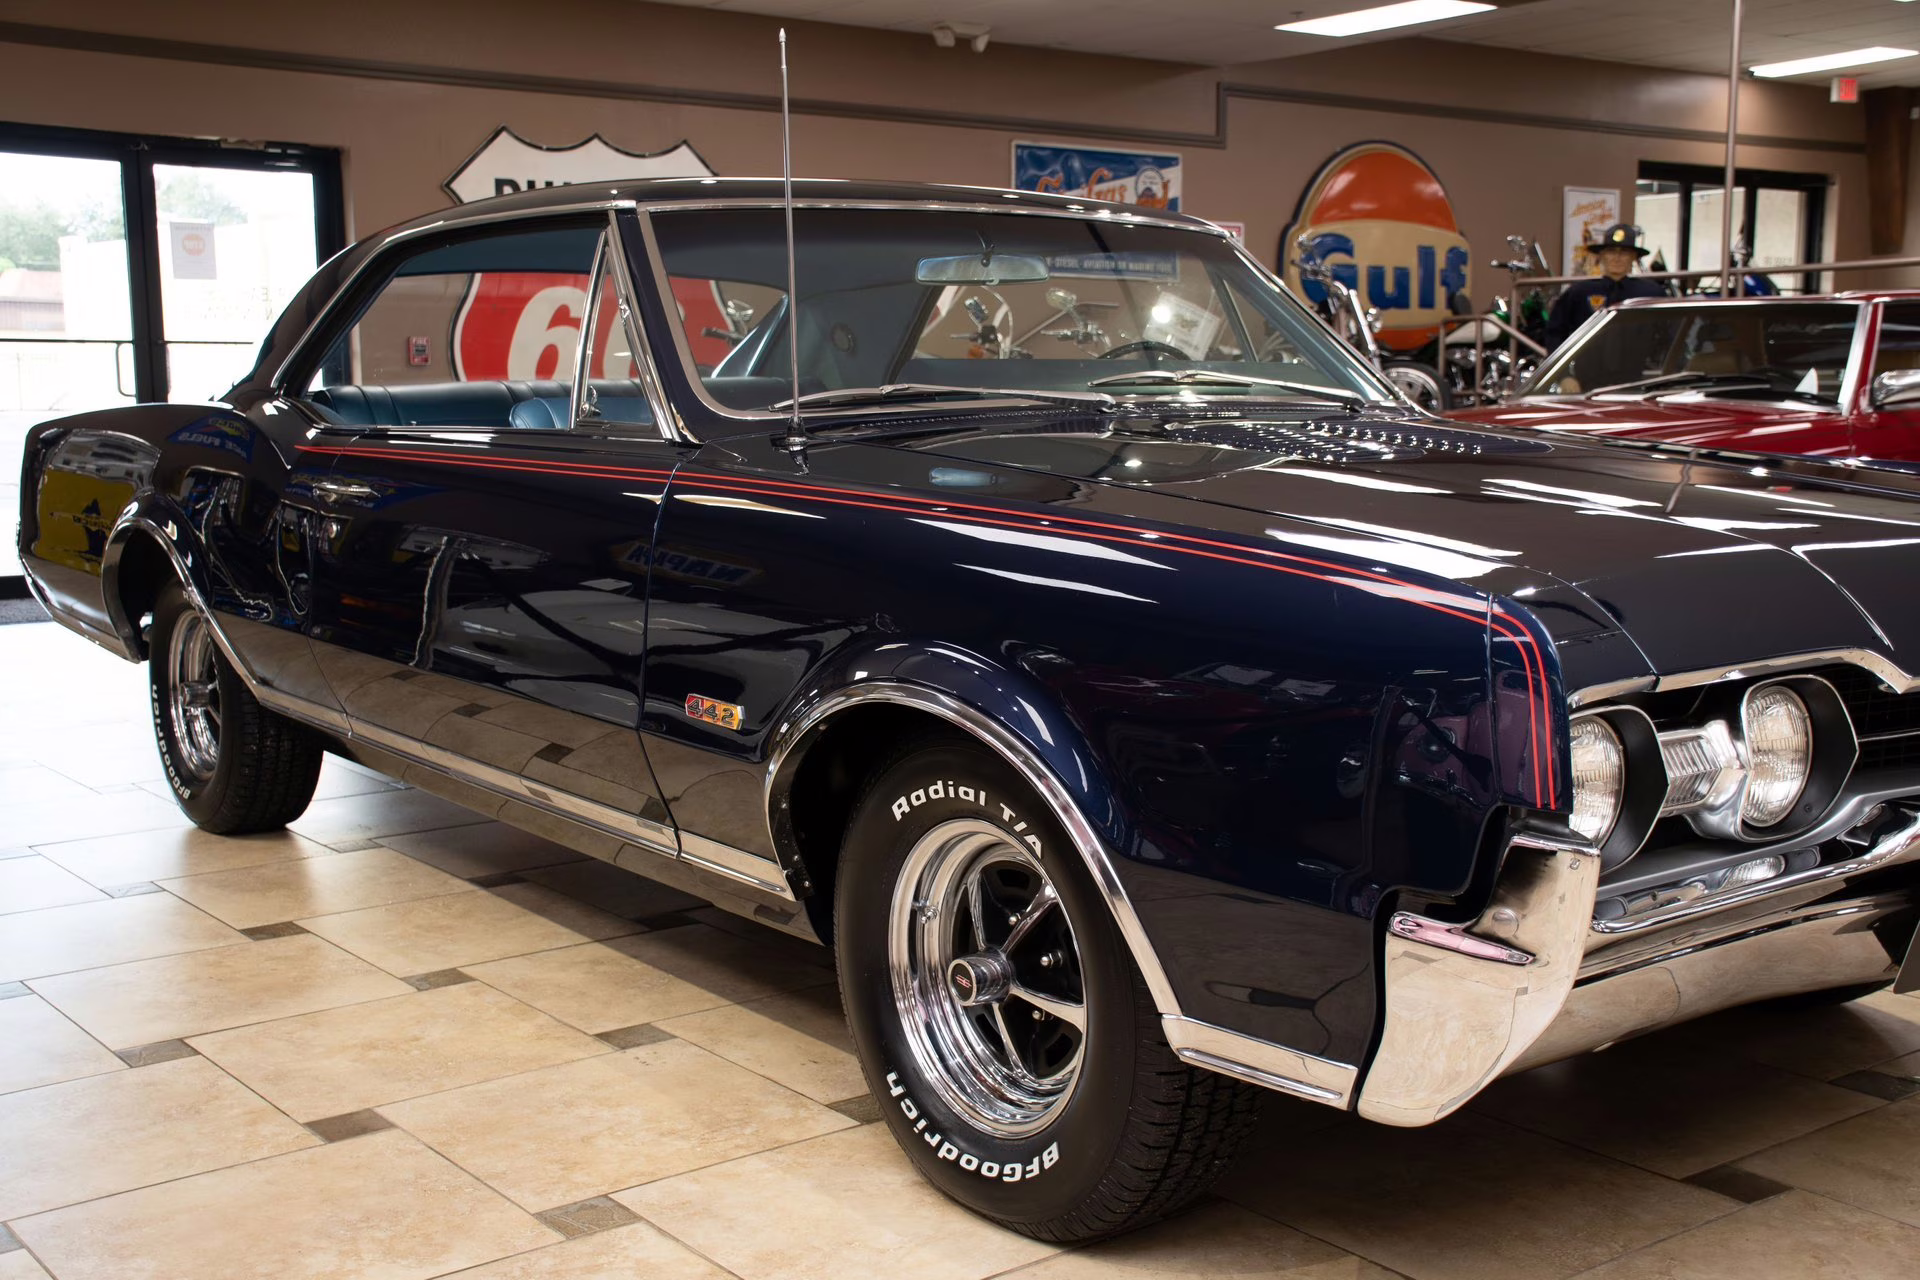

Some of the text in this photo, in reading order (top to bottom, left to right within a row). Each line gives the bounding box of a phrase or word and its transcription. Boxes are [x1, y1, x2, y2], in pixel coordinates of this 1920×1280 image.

[1300, 233, 1468, 310] Gulf
[686, 697, 737, 727] 442
[891, 780, 1043, 859] Radial T/A
[886, 1071, 1060, 1182] BFGoodrich
